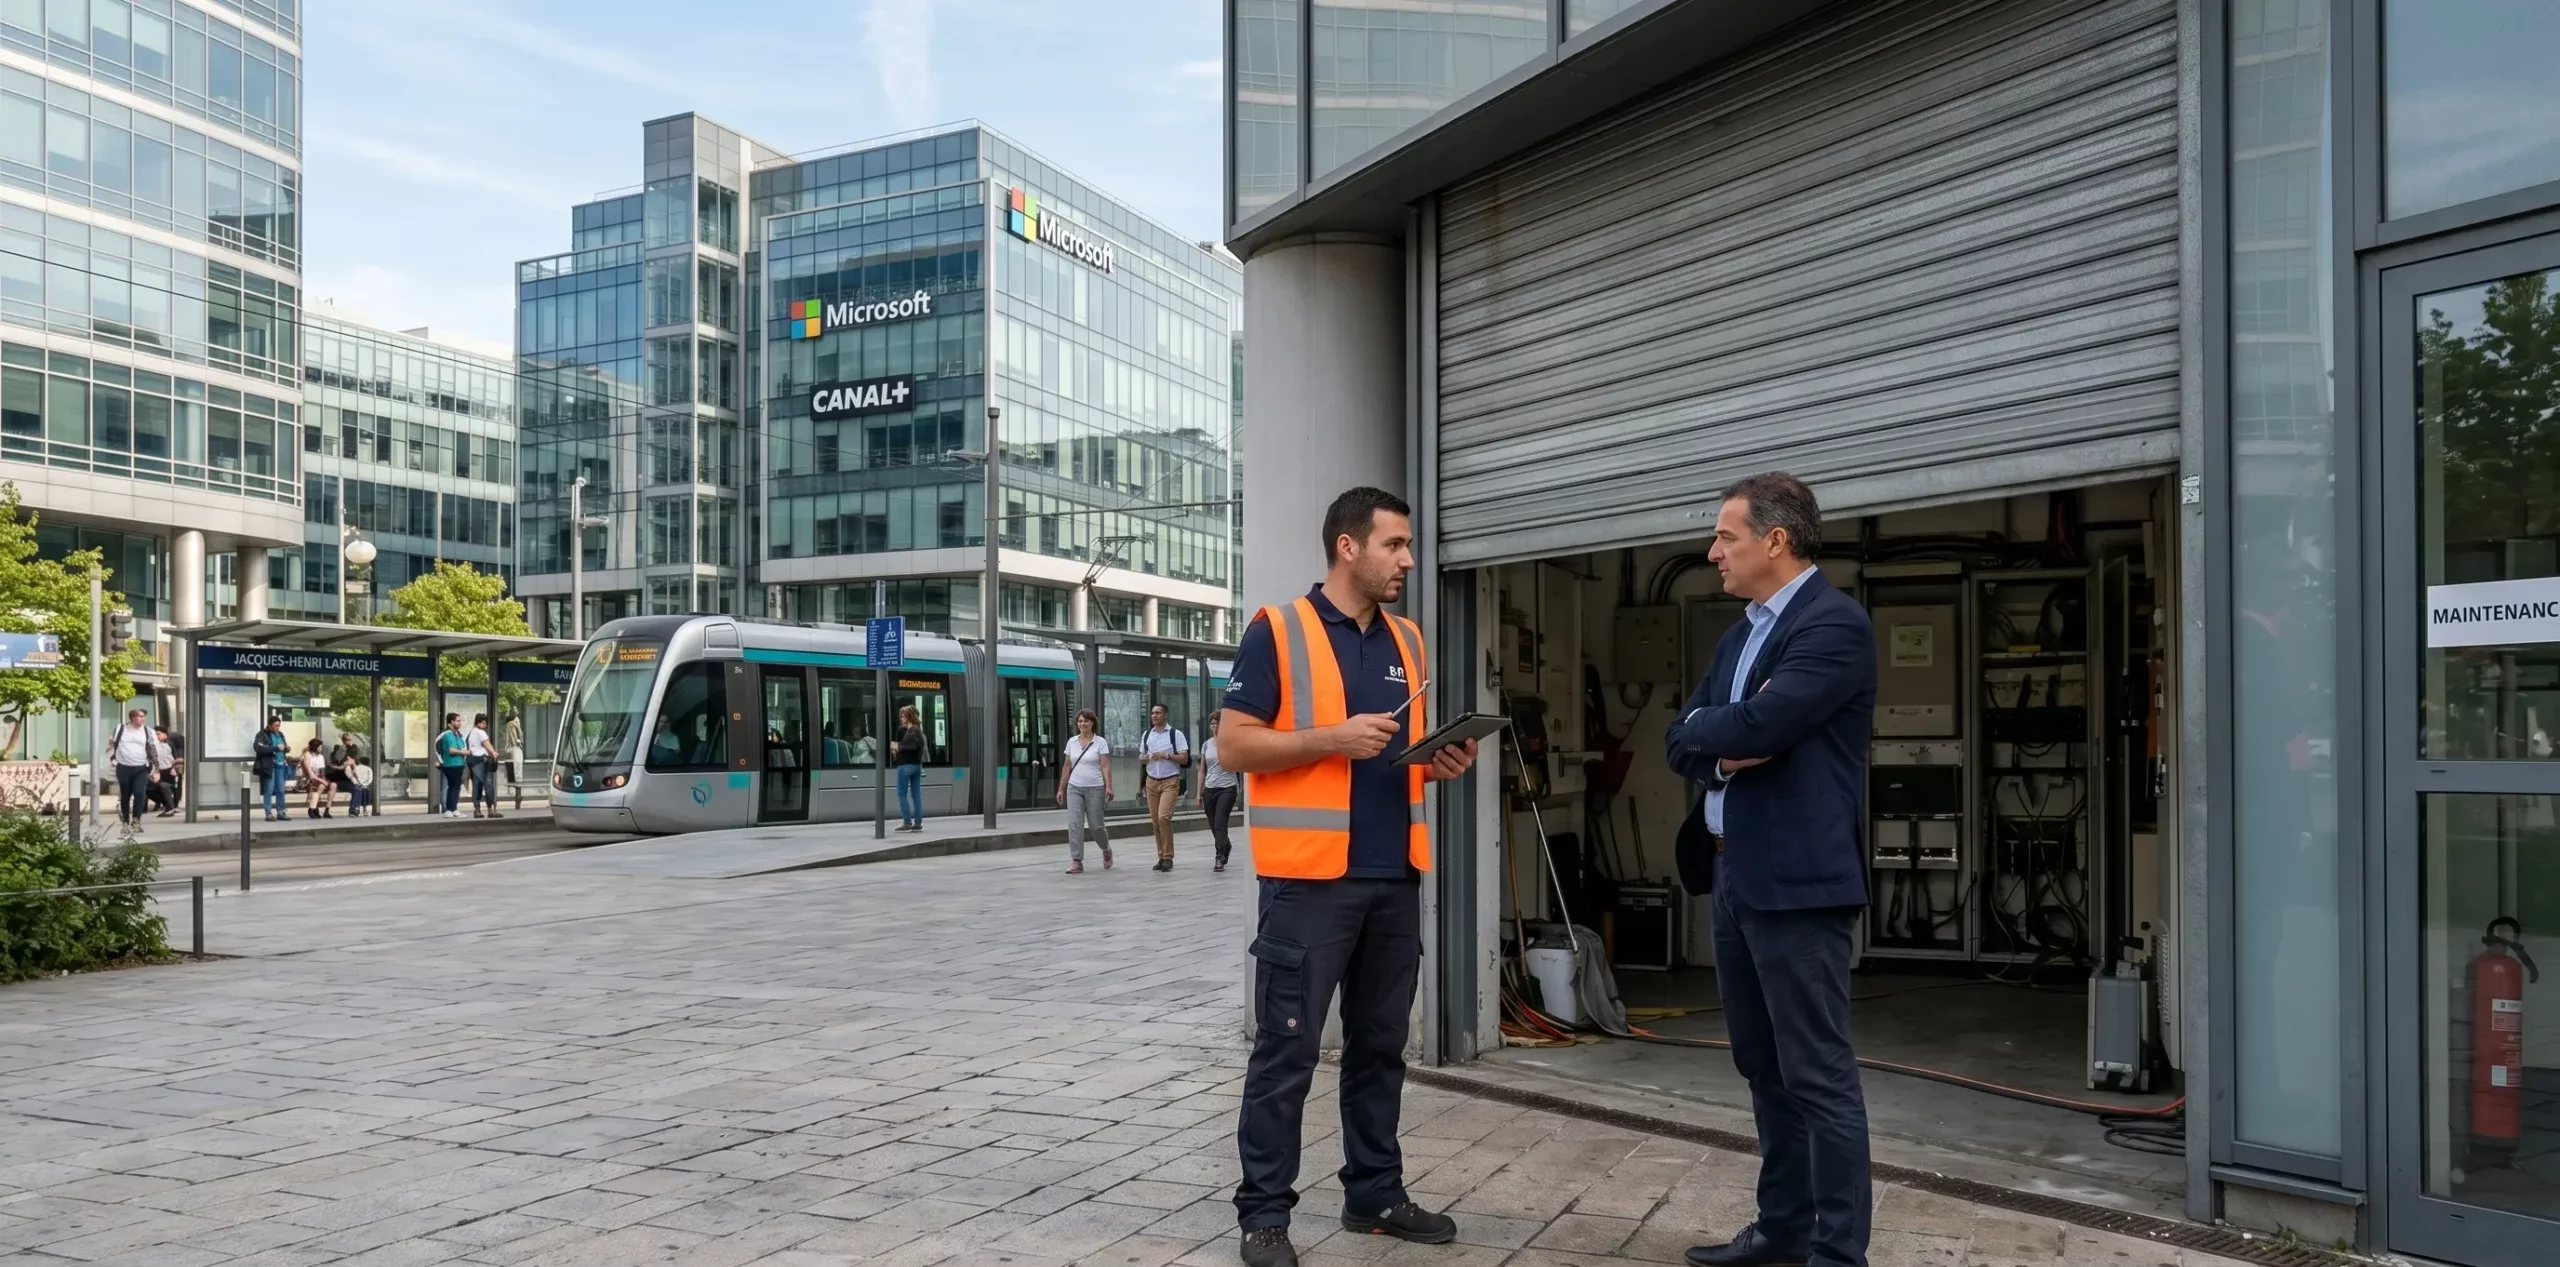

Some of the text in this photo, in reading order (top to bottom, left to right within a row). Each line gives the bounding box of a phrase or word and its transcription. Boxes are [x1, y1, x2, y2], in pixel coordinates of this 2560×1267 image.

[1039, 209, 1114, 273] Microsoft
[826, 289, 931, 328] Microsoft
[812, 381, 910, 413] CANAL+
[2433, 601, 2560, 624] MAINTENANC
[234, 653, 380, 672] JACQUES-HENRI LARTIGUE
